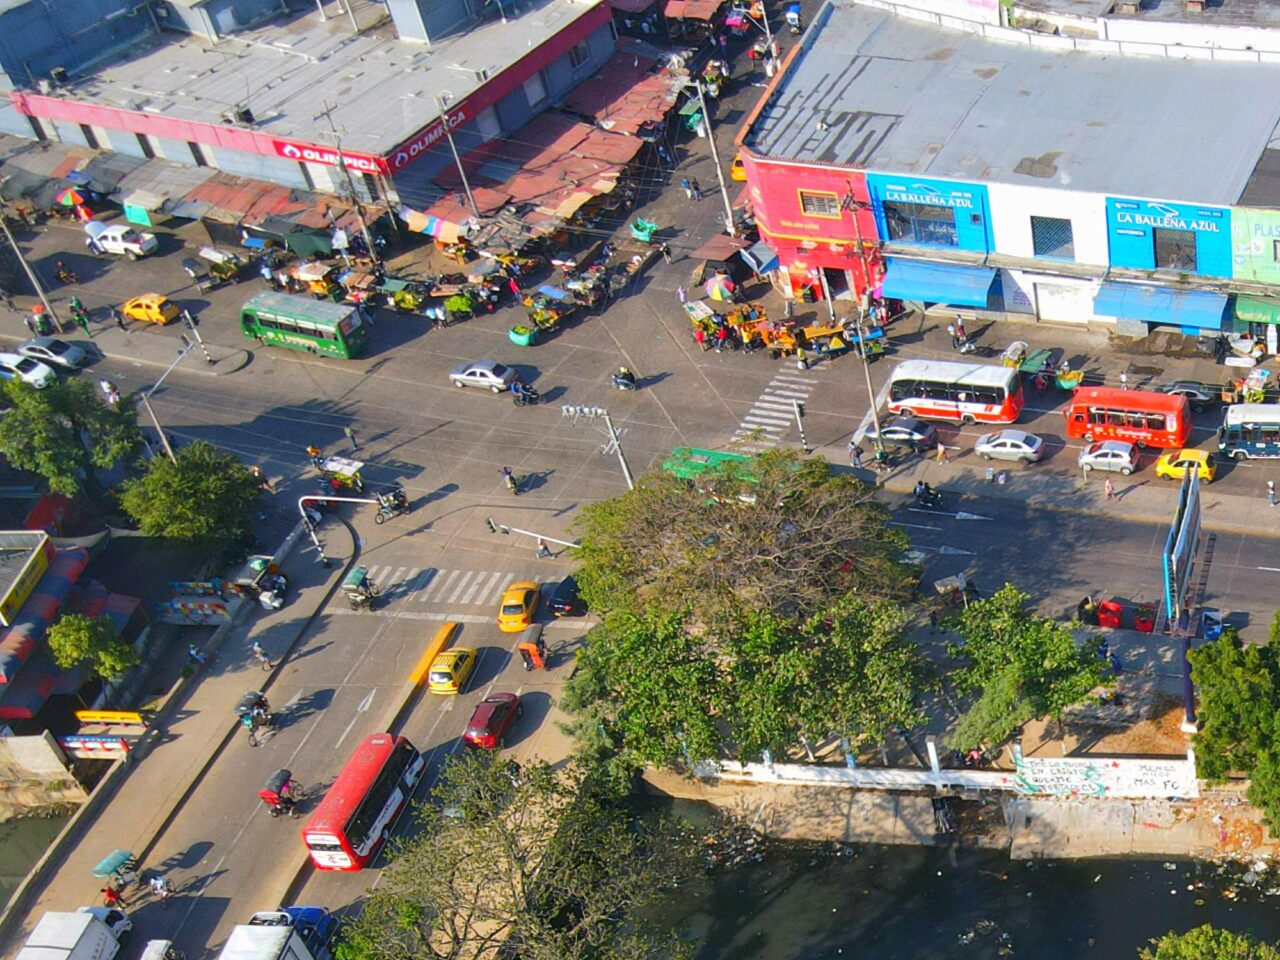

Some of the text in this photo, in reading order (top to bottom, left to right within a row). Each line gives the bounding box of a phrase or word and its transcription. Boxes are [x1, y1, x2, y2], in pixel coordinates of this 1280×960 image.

[410, 112, 465, 156] OLIMPCA
[886, 192, 899, 201] LA
[948, 198, 974, 208] AZUL
[1117, 213, 1219, 232] LA BALLENA AZUL
